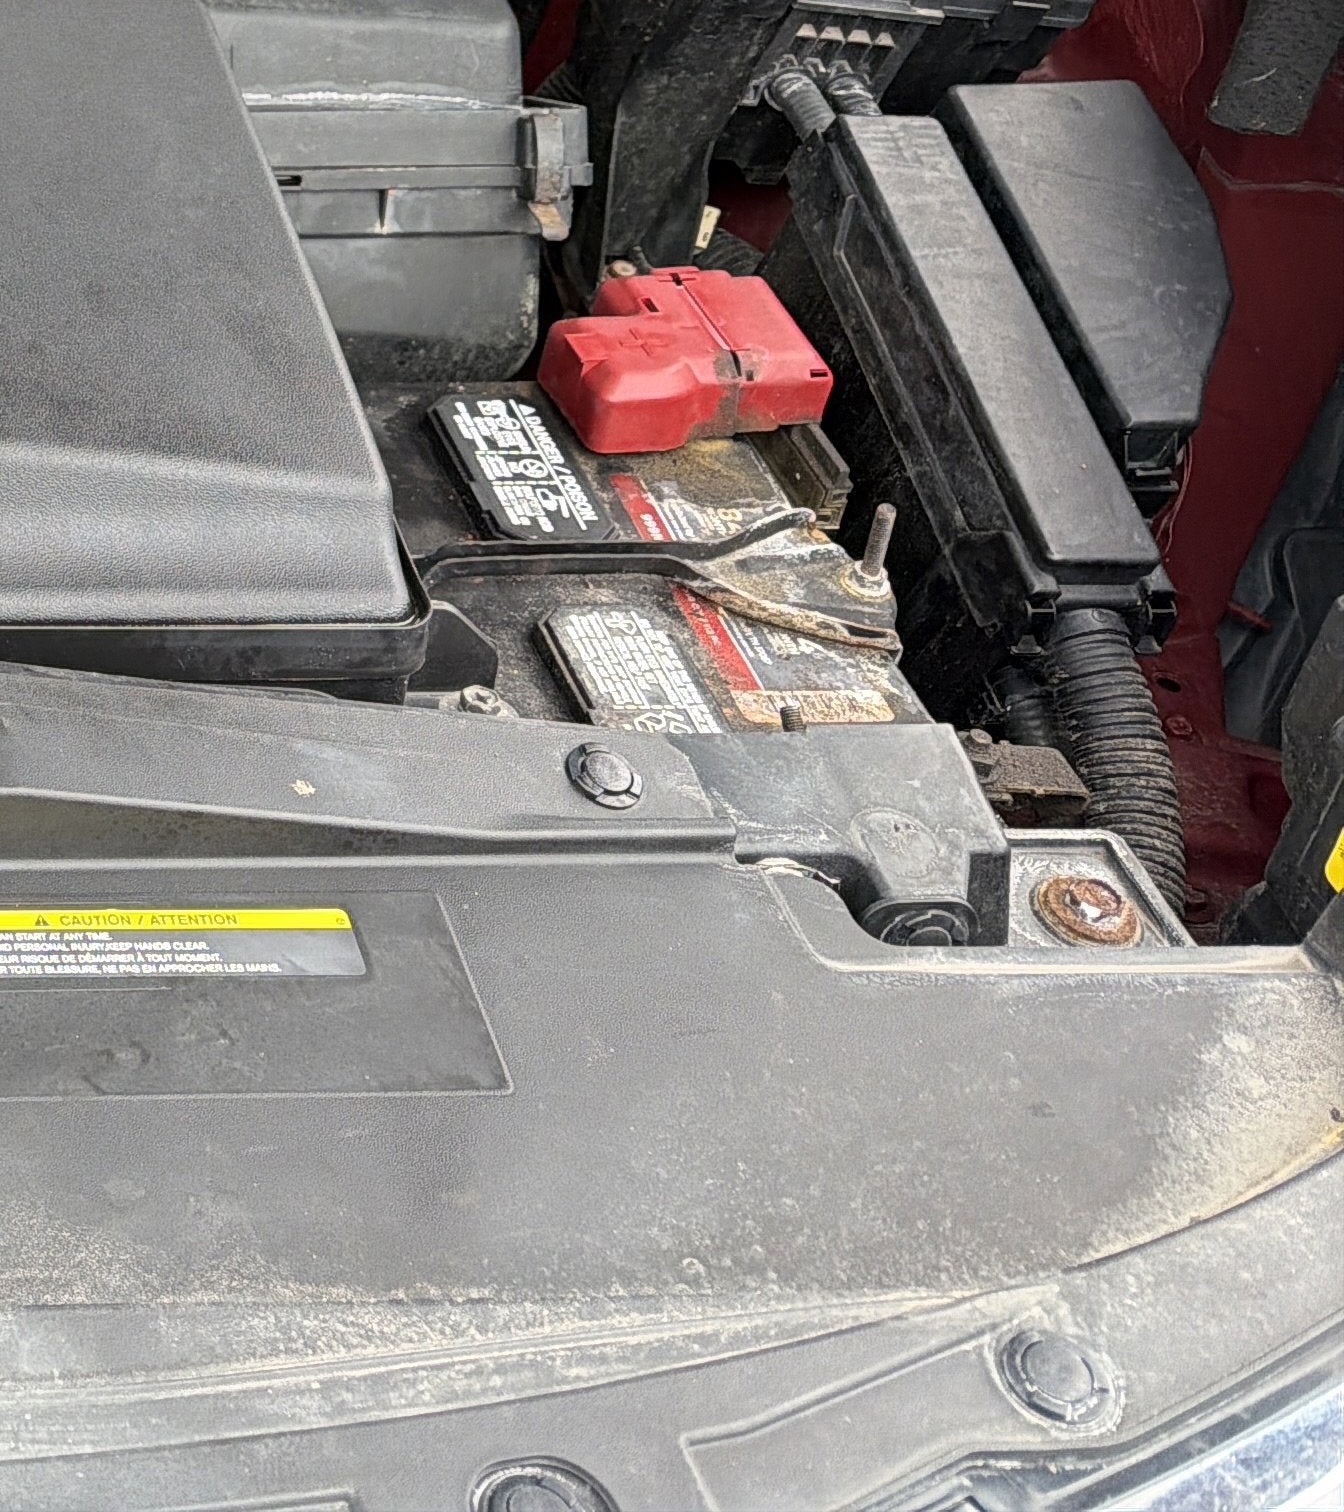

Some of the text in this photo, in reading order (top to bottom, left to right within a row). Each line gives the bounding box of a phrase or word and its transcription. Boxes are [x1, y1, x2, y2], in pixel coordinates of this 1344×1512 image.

[524, 415, 565, 464] DANGER
[559, 475, 598, 520] POISON
[58, 915, 132, 926] CAUTION
[150, 914, 238, 925] ATTENTION
[15, 932, 47, 941] START
[49, 932, 62, 941] AT
[63, 932, 85, 941] ANY
[13, 942, 69, 952] PERSONAL
[134, 941, 171, 950] HANDS
[173, 941, 210, 950] CLEAR.
[20, 954, 60, 965] RISQUE
[61, 954, 76, 963] DE
[78, 952, 134, 963] DÉMARRER
[147, 953, 173, 962] TOUT
[174, 953, 223, 962] MOMENT.
[10, 964, 42, 974] TOUTE
[103, 965, 118, 973] NE
[119, 964, 140, 973] PAS
[141, 964, 157, 973] EN
[158, 963, 223, 973] APPROCHER
[224, 963, 245, 973] LES
[246, 963, 282, 973] MAINS.
